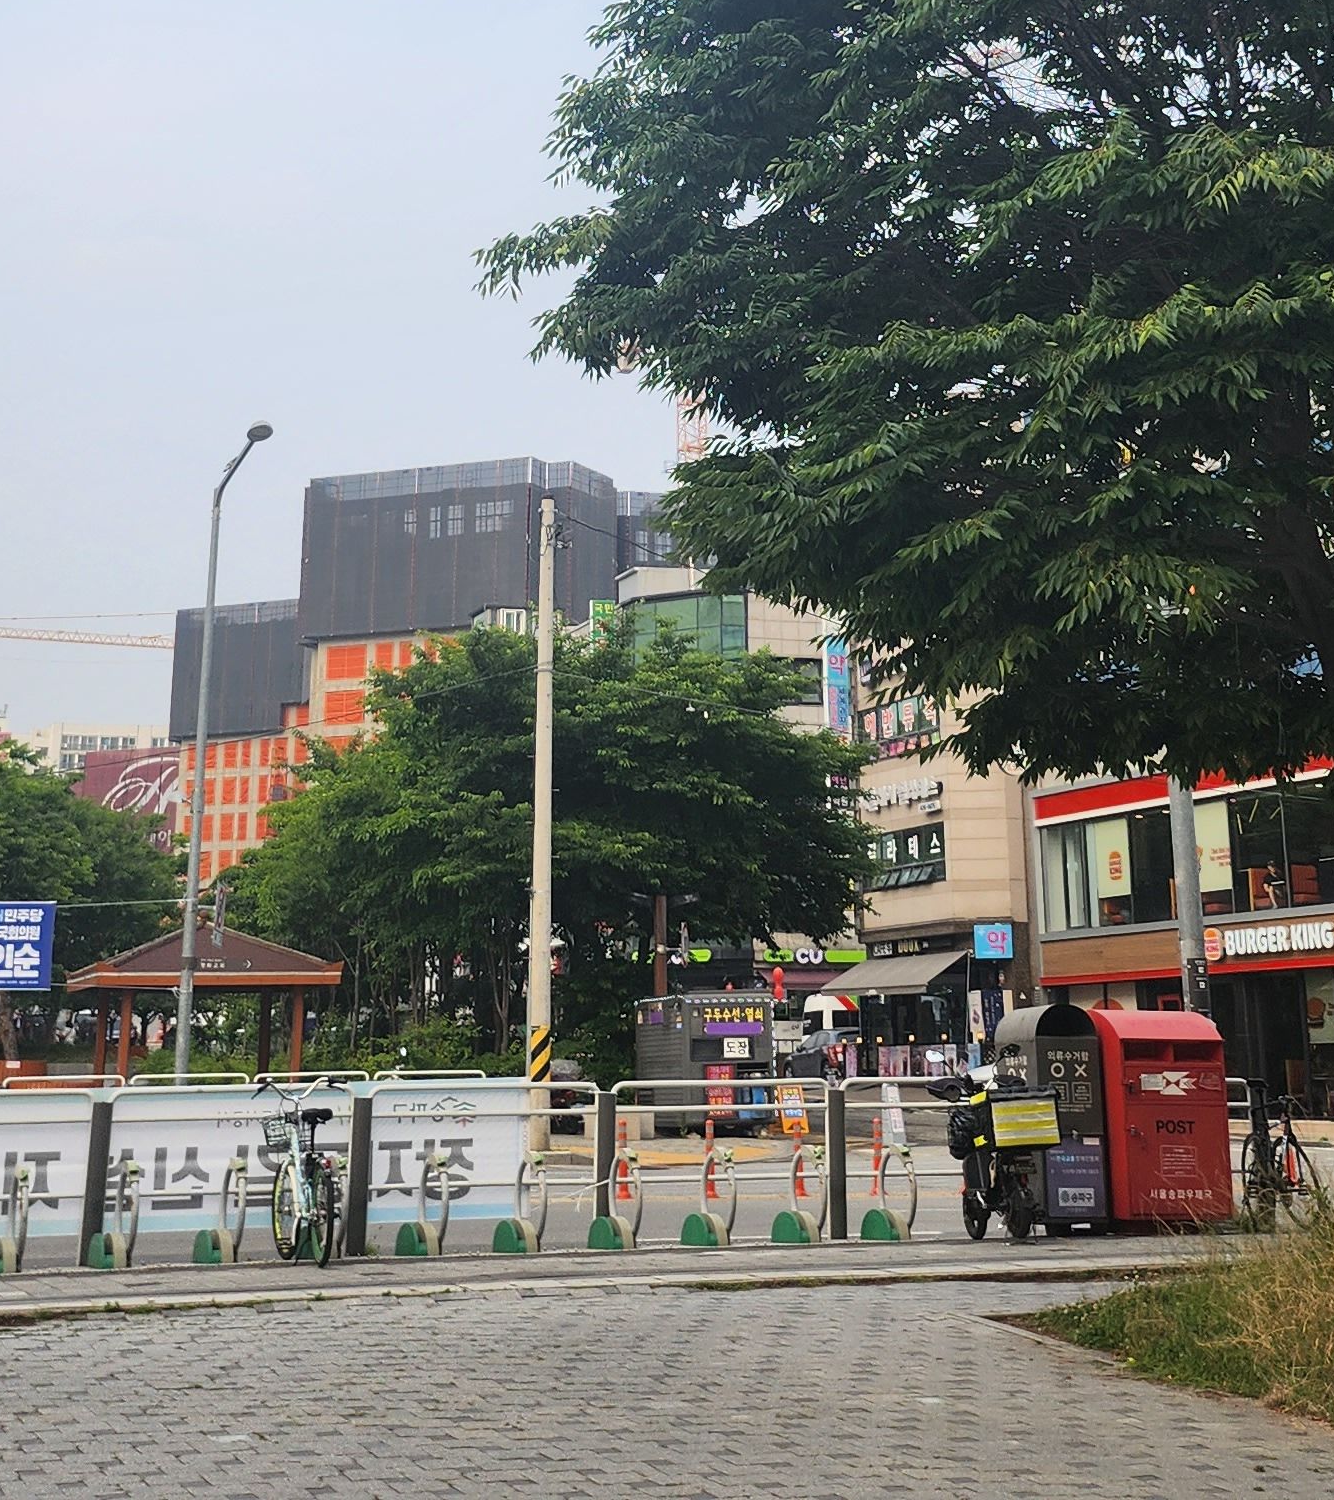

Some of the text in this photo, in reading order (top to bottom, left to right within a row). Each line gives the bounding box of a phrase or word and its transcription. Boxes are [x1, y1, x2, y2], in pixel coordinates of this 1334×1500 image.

[829, 655, 846, 675] 약
[988, 931, 1008, 954] 약
[1224, 926, 1290, 956] BURGER
[795, 947, 823, 964] CU
[726, 1040, 747, 1055] 도장
[1047, 1051, 1089, 1062] 의류수거함
[1156, 1120, 1196, 1134] POST
[1070, 1192, 1093, 1204] 송파구
[1150, 1188, 1213, 1200] 서울송파우체국
